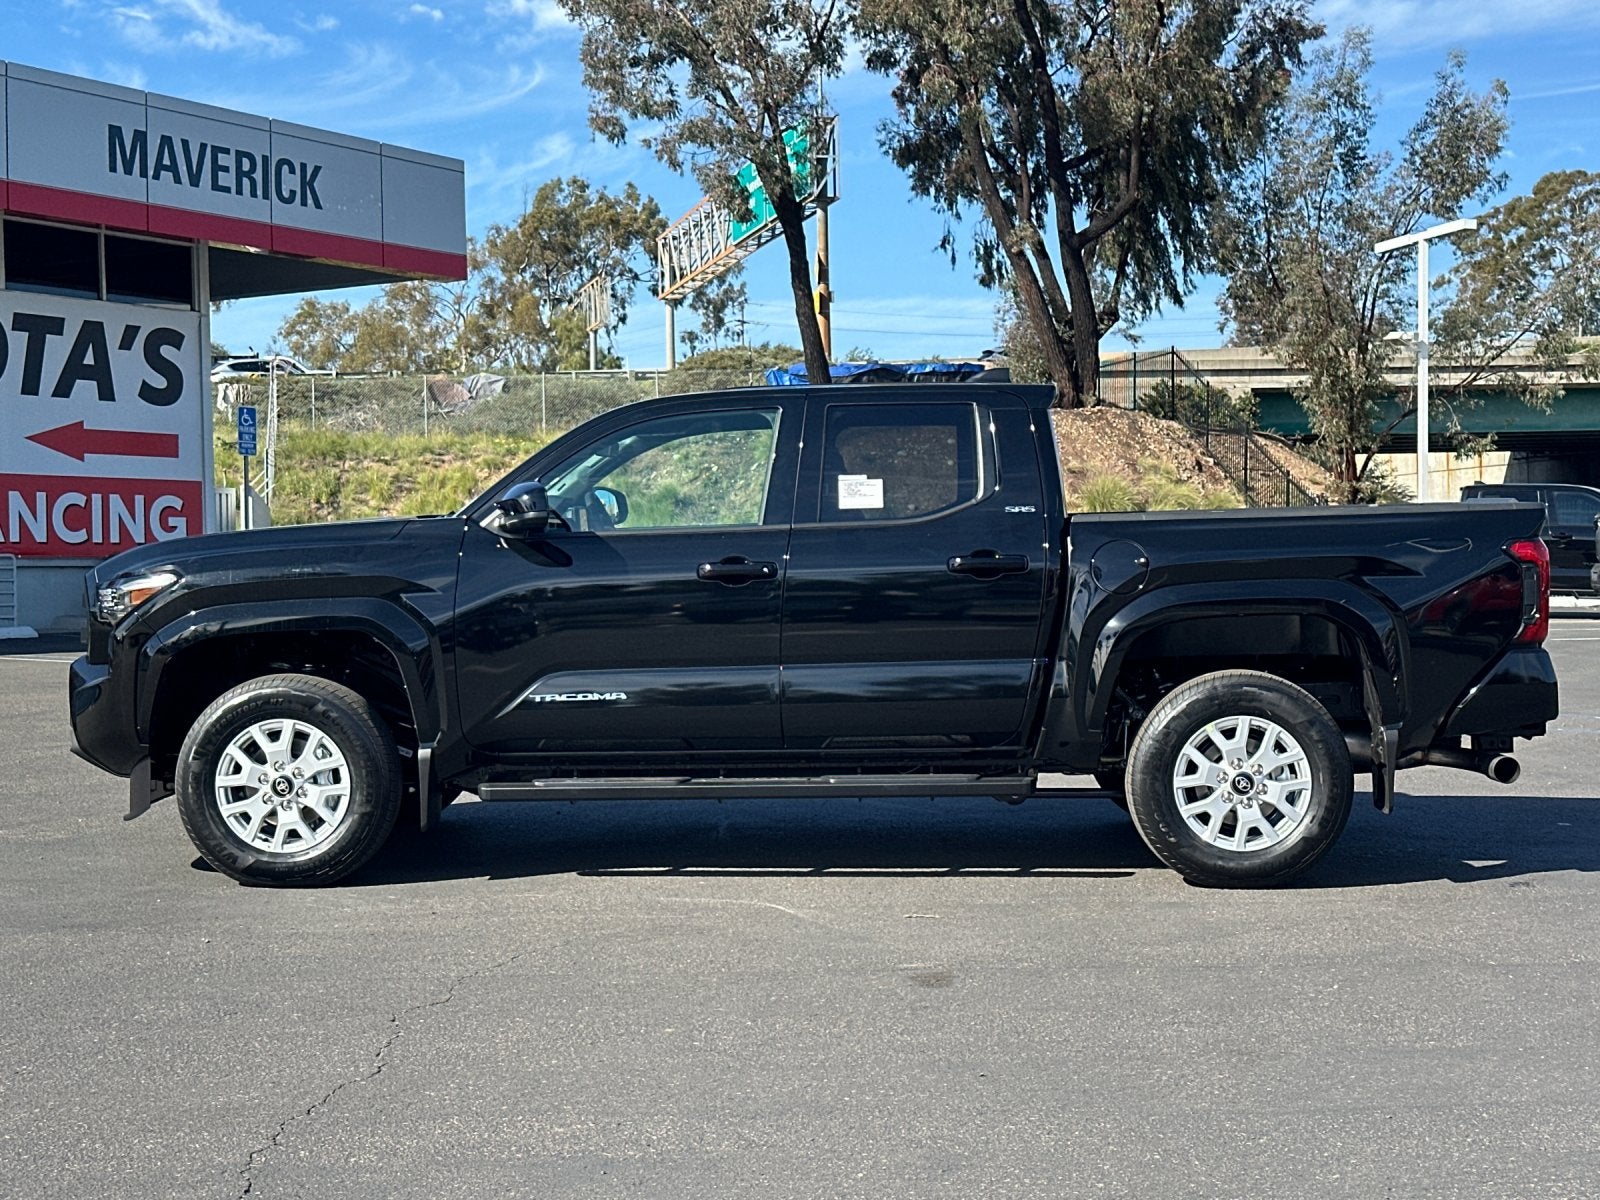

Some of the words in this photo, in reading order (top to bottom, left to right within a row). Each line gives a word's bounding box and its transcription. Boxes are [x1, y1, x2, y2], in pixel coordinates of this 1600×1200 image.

[108, 123, 323, 210] MAVERICK
[0, 490, 188, 545] NCING
[528, 692, 628, 702] TACOMA
